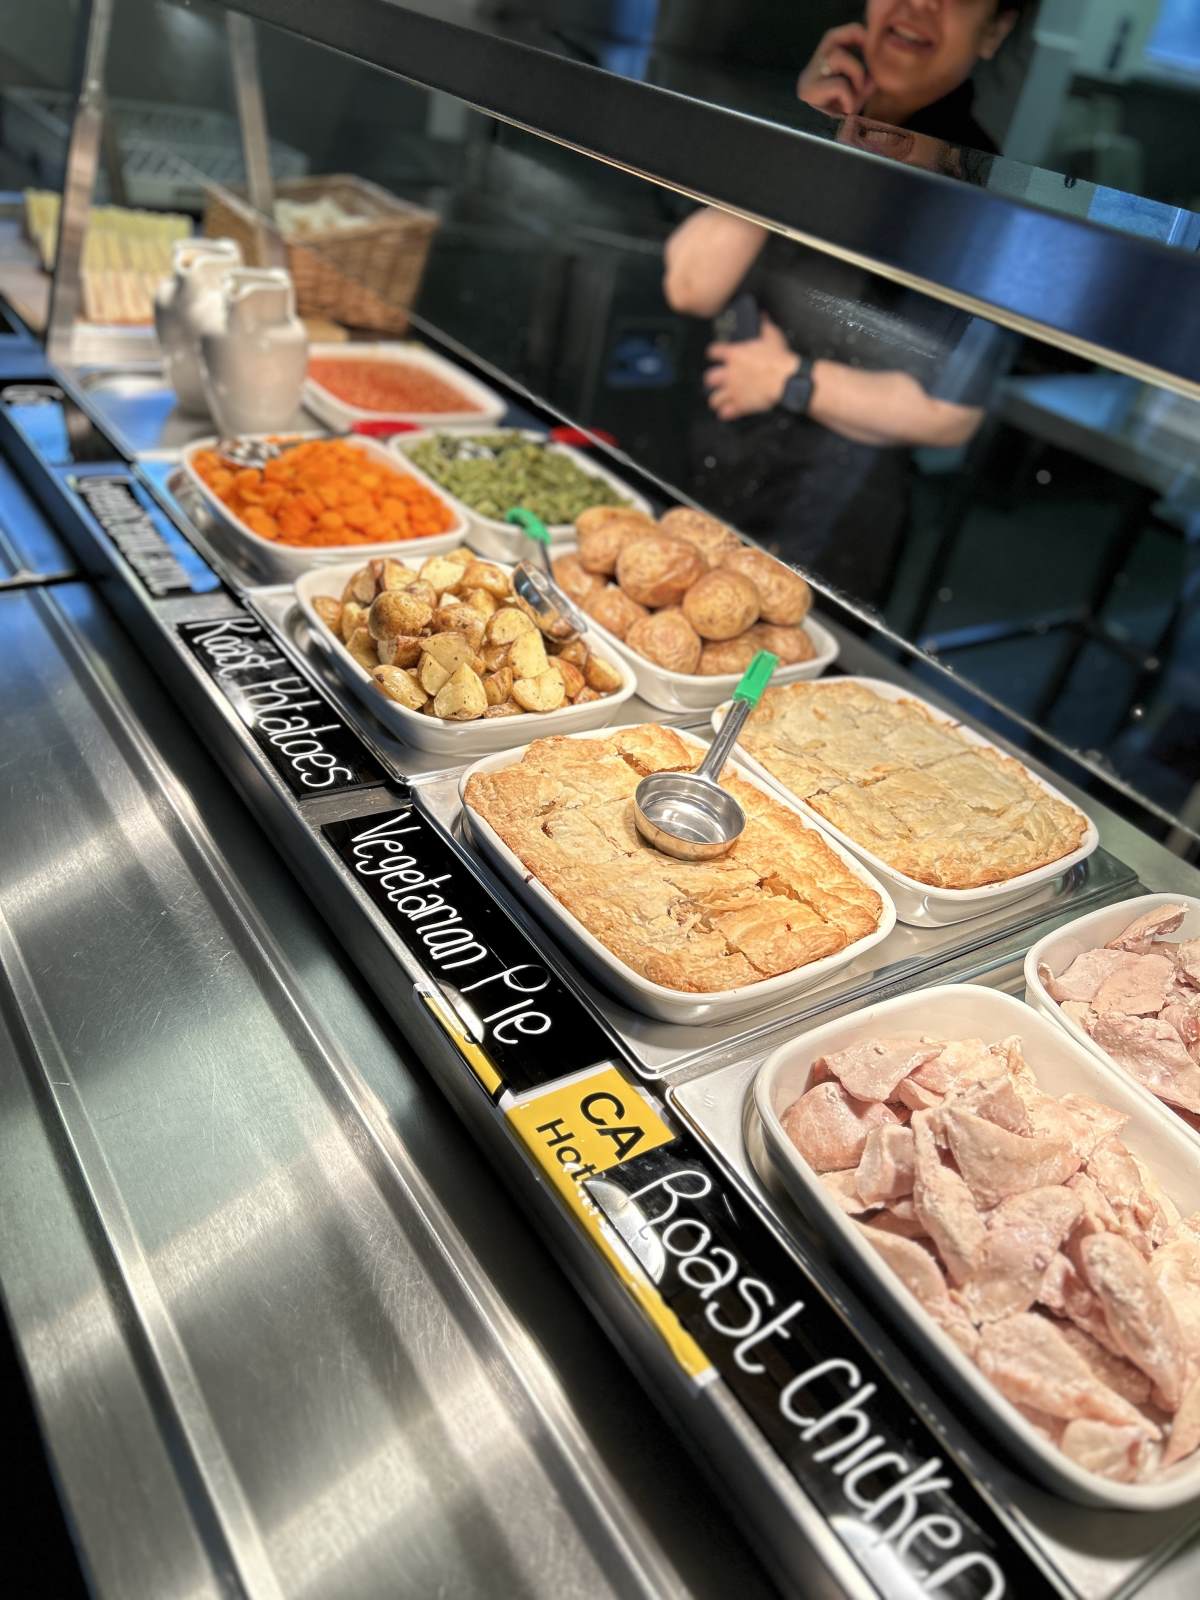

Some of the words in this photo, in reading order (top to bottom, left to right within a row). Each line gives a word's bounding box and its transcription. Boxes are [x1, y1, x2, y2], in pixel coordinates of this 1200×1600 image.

[184, 617, 287, 679] Roast
[240, 675, 352, 788] Potatoes
[351, 811, 488, 970] Vegetarian
[459, 964, 552, 1045] Pie
[620, 1169, 805, 1375] Roast
[779, 1358, 1006, 1600] Chicken
